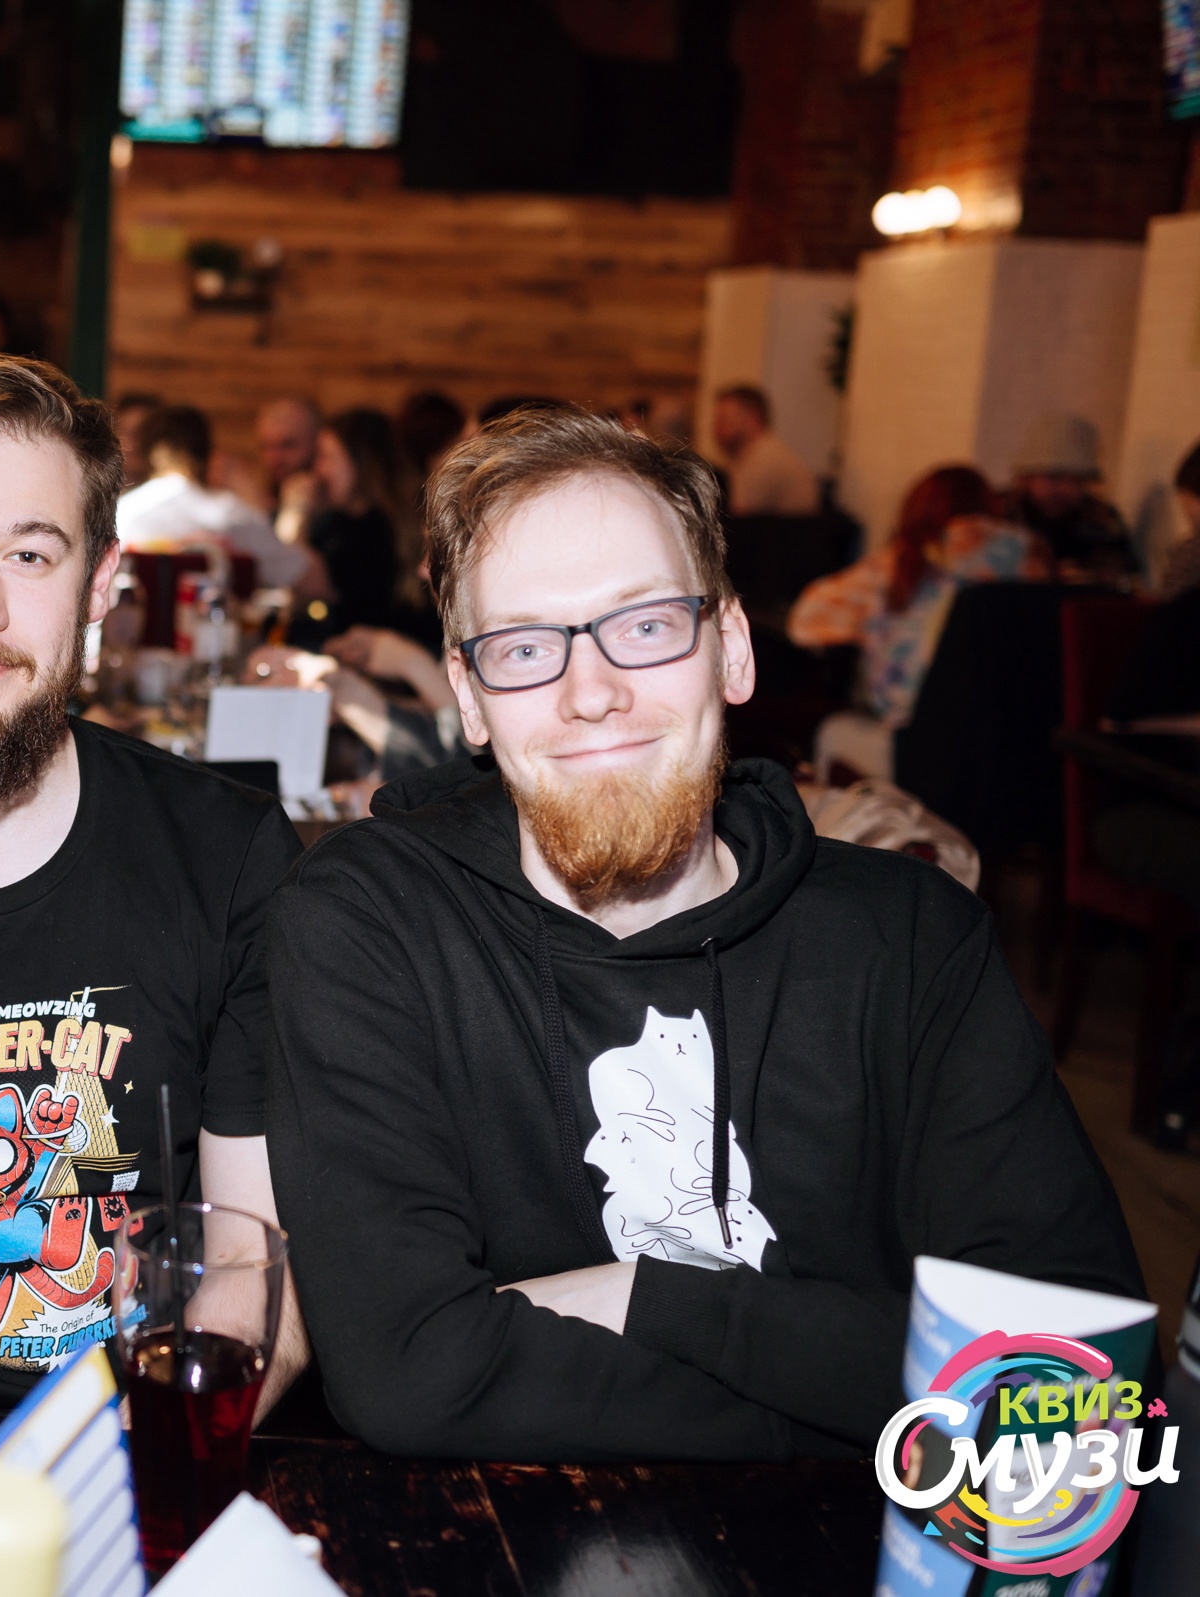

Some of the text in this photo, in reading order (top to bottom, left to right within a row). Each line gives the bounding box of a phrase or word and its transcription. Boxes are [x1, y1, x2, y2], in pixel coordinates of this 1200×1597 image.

[39, 1310, 95, 1334] The Origin of
[56, 1311, 127, 1358] PURRRKE
